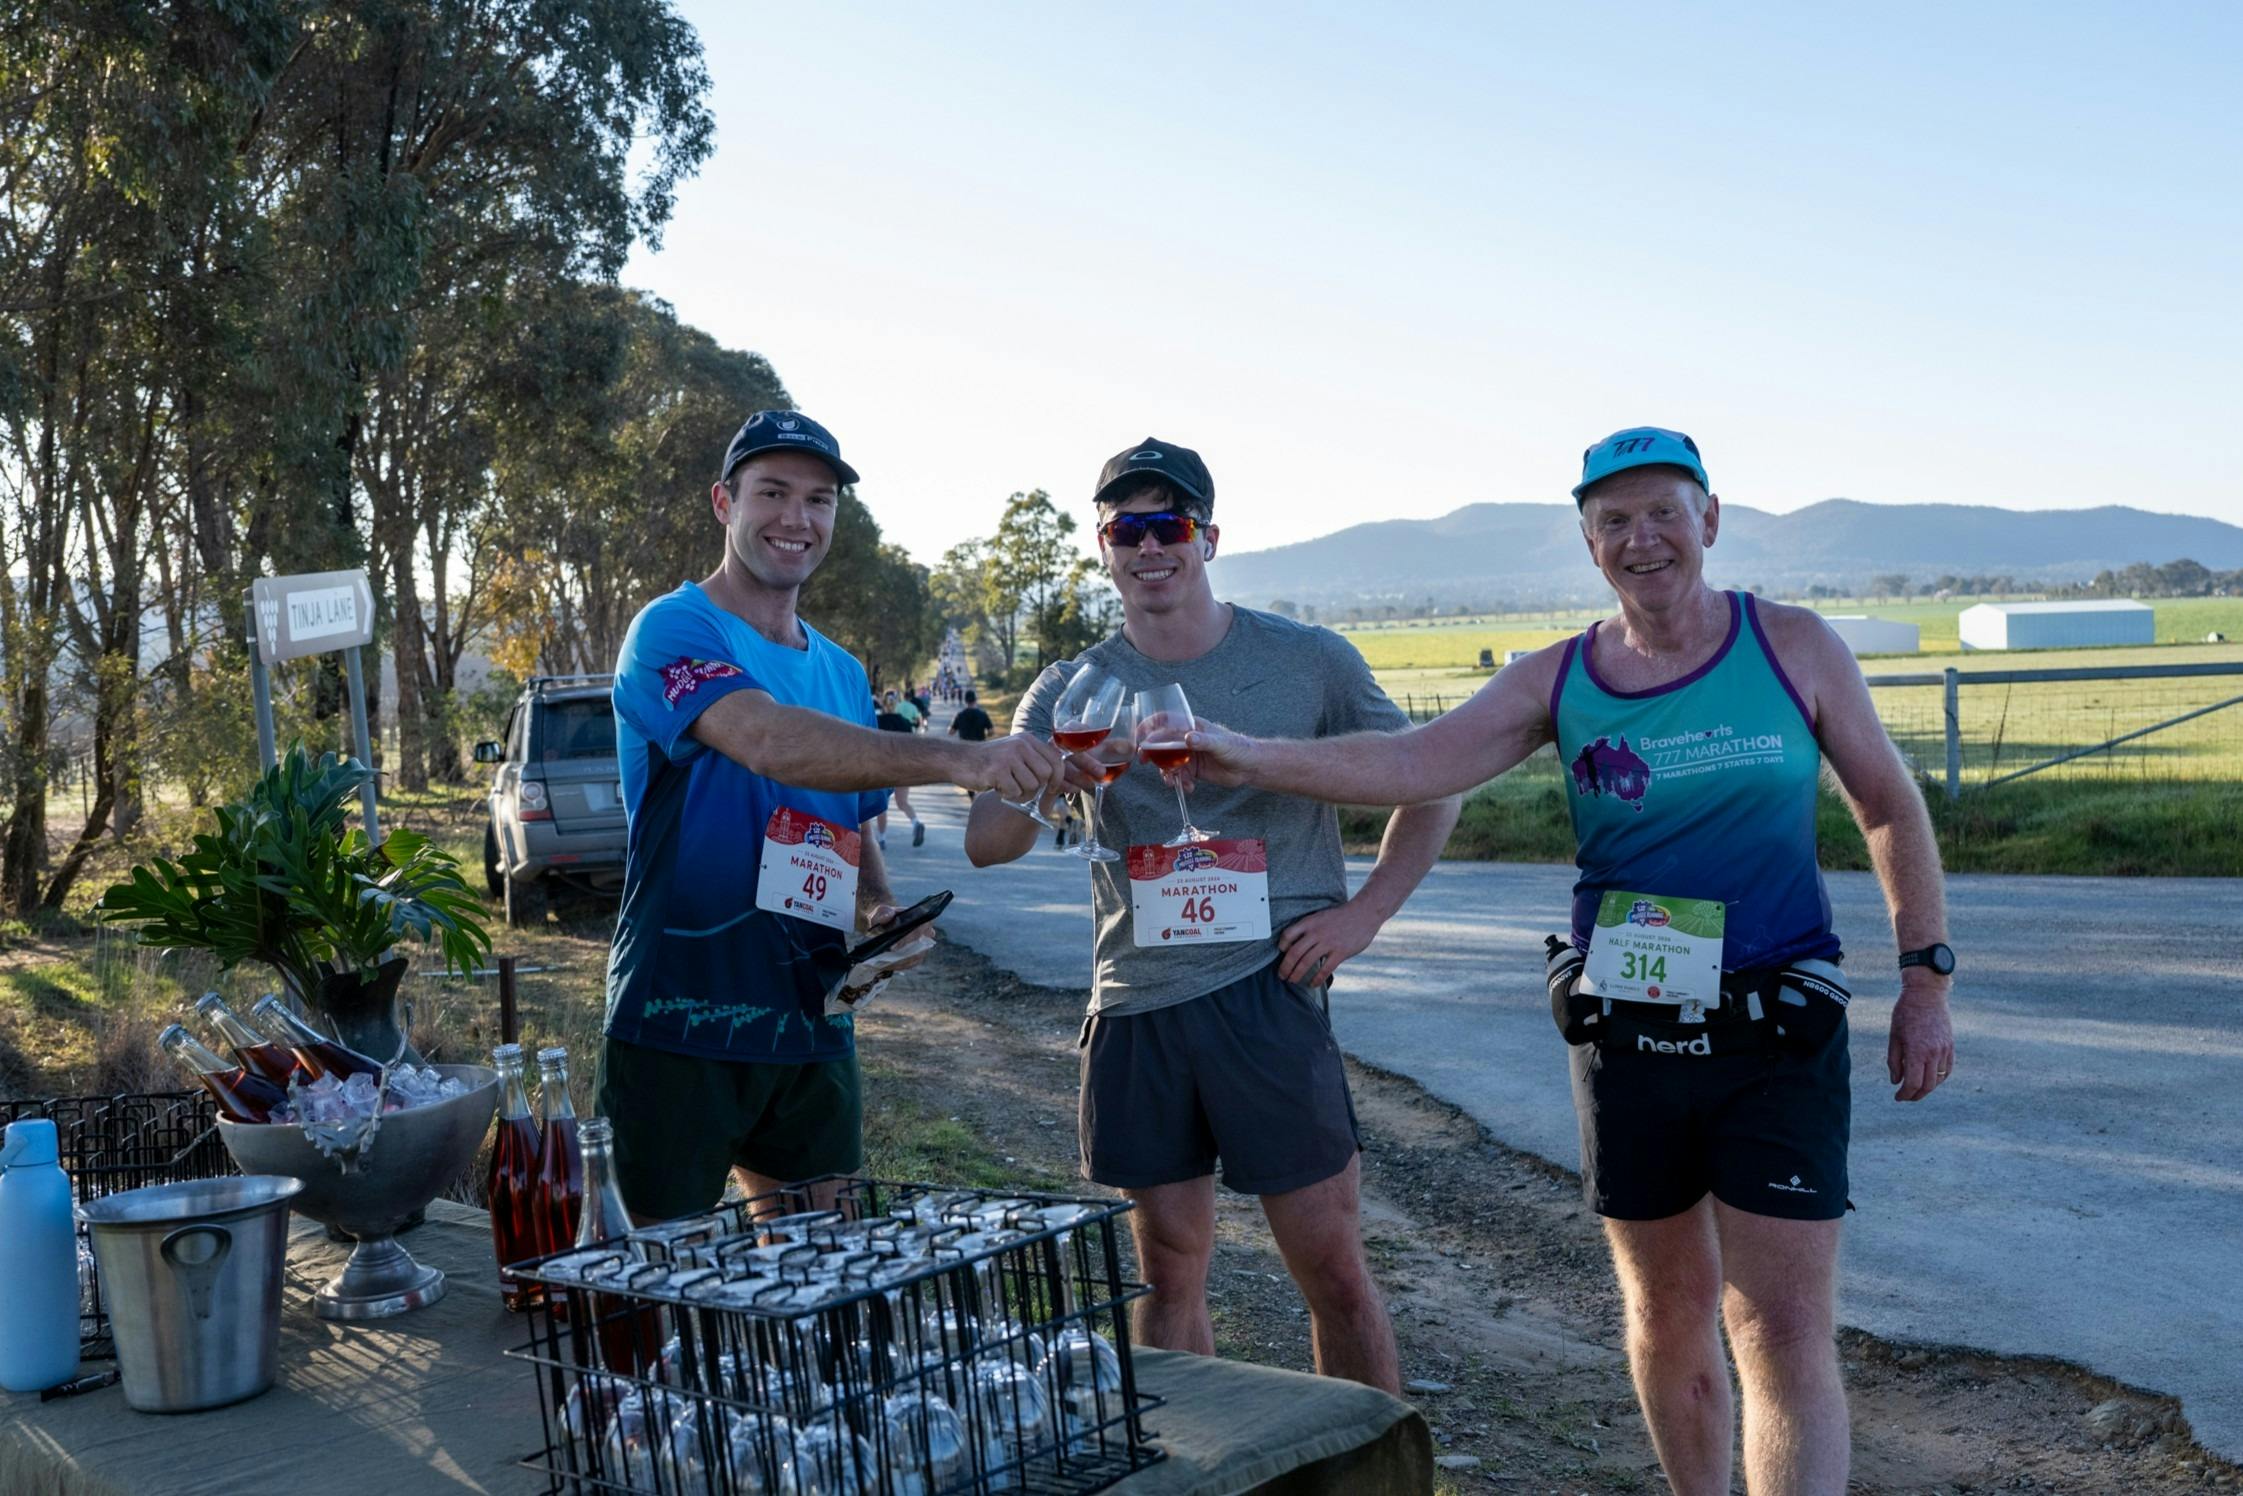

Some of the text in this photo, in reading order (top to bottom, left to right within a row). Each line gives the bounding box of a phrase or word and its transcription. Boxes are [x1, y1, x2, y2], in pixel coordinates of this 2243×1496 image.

[291, 597, 354, 630] TINJA LANE
[1653, 735, 1783, 766] 777 MARATHON
[1663, 764, 1716, 779] MARATHONS
[1724, 758, 1755, 769] STATES
[1763, 756, 1784, 764] DAYS
[790, 855, 843, 881] MARATHON
[802, 873, 827, 901] 49
[1161, 884, 1238, 897] MARATHON
[1181, 896, 1215, 923] 46
[1172, 928, 1201, 937] YANCOAL
[1608, 937, 1691, 955] HALF MARATHON
[1620, 951, 1667, 983] 314
[1637, 1032, 1712, 1056] nerd
